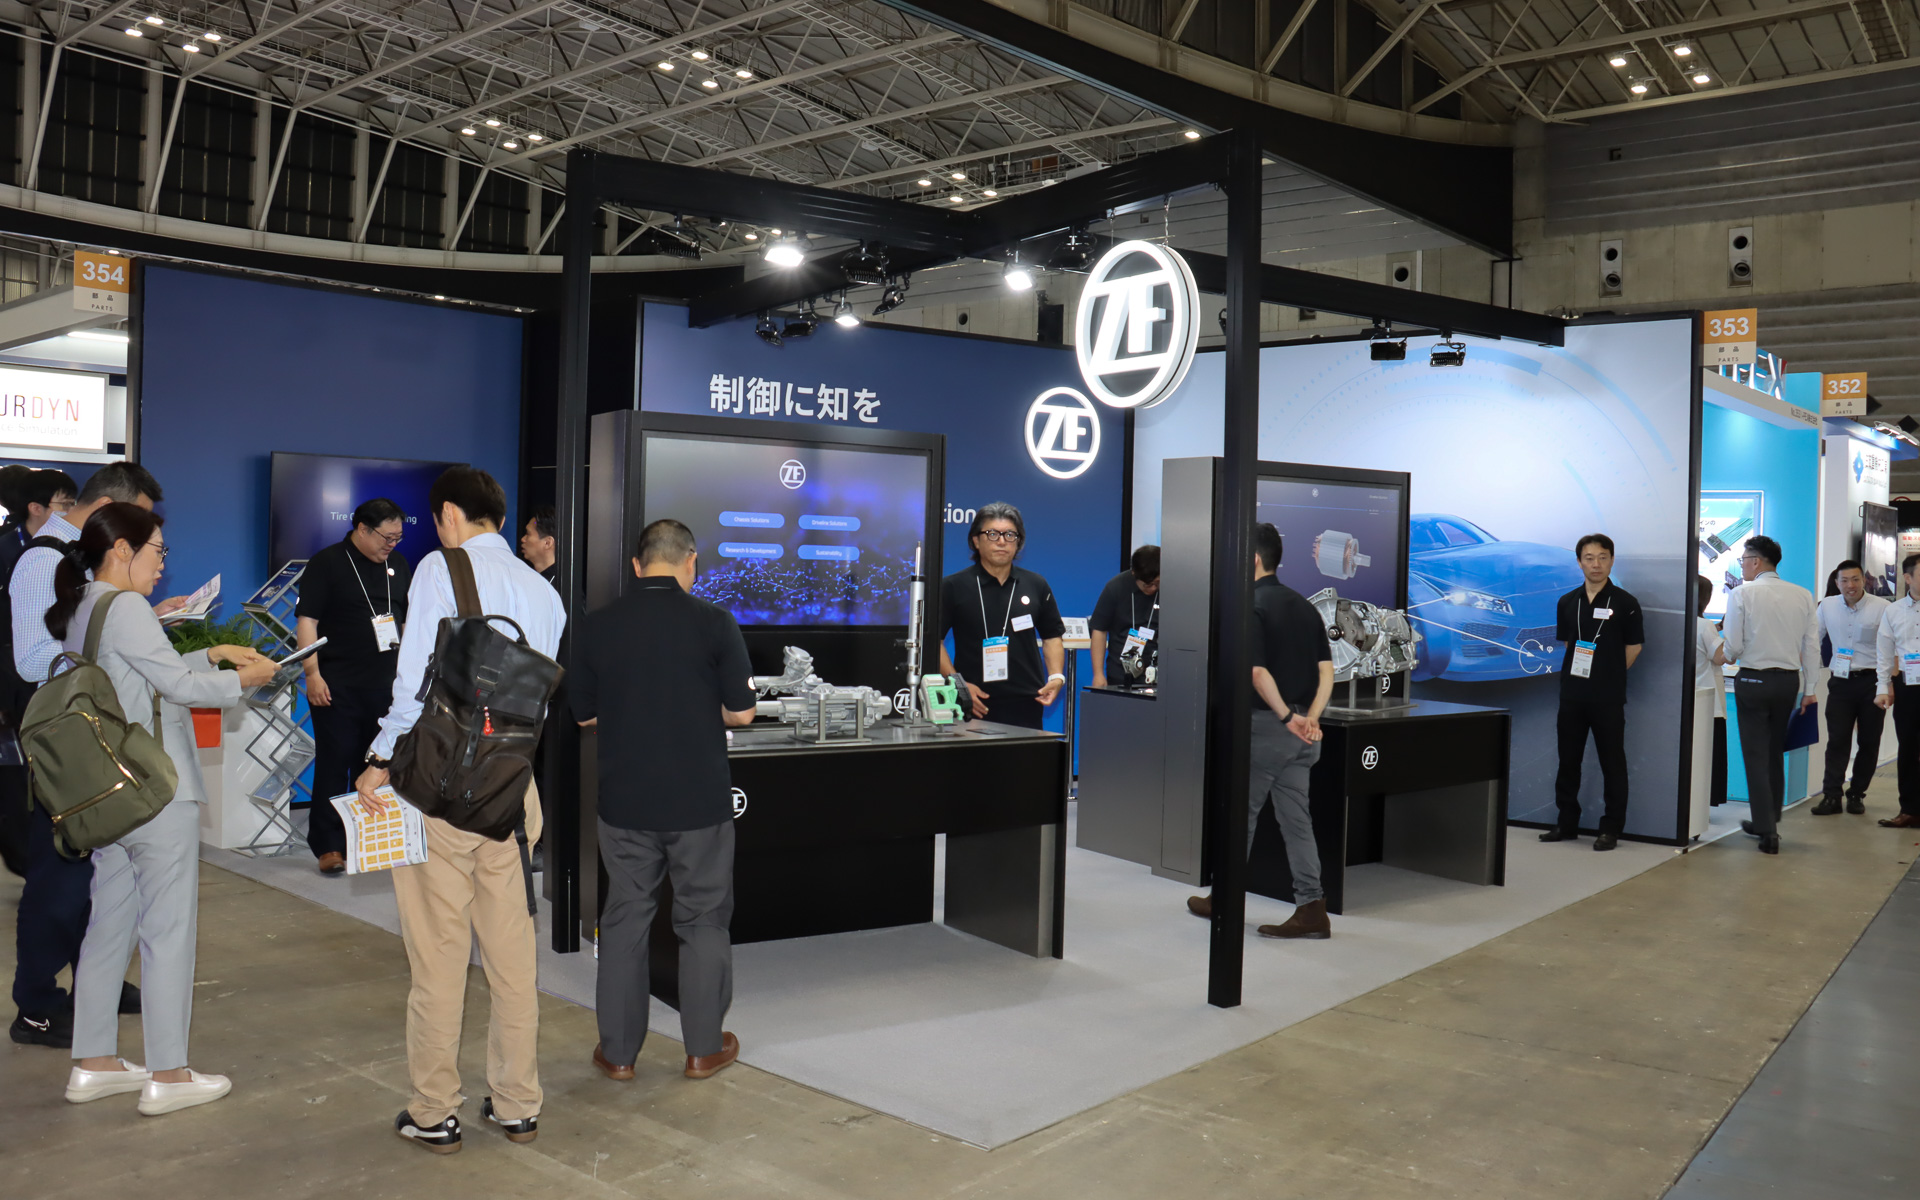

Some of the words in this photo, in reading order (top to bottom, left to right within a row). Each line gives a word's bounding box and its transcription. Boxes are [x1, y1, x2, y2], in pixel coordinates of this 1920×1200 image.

[82, 260, 125, 286] 354
[91, 303, 114, 312] PARTS
[1709, 316, 1750, 338] 353
[1827, 378, 1861, 395] 352
[709, 373, 881, 423] 制御に知を
[18, 422, 78, 436] Simulation
[330, 511, 348, 521] Tire
[725, 546, 745, 554] Research
[750, 547, 777, 556] Development
